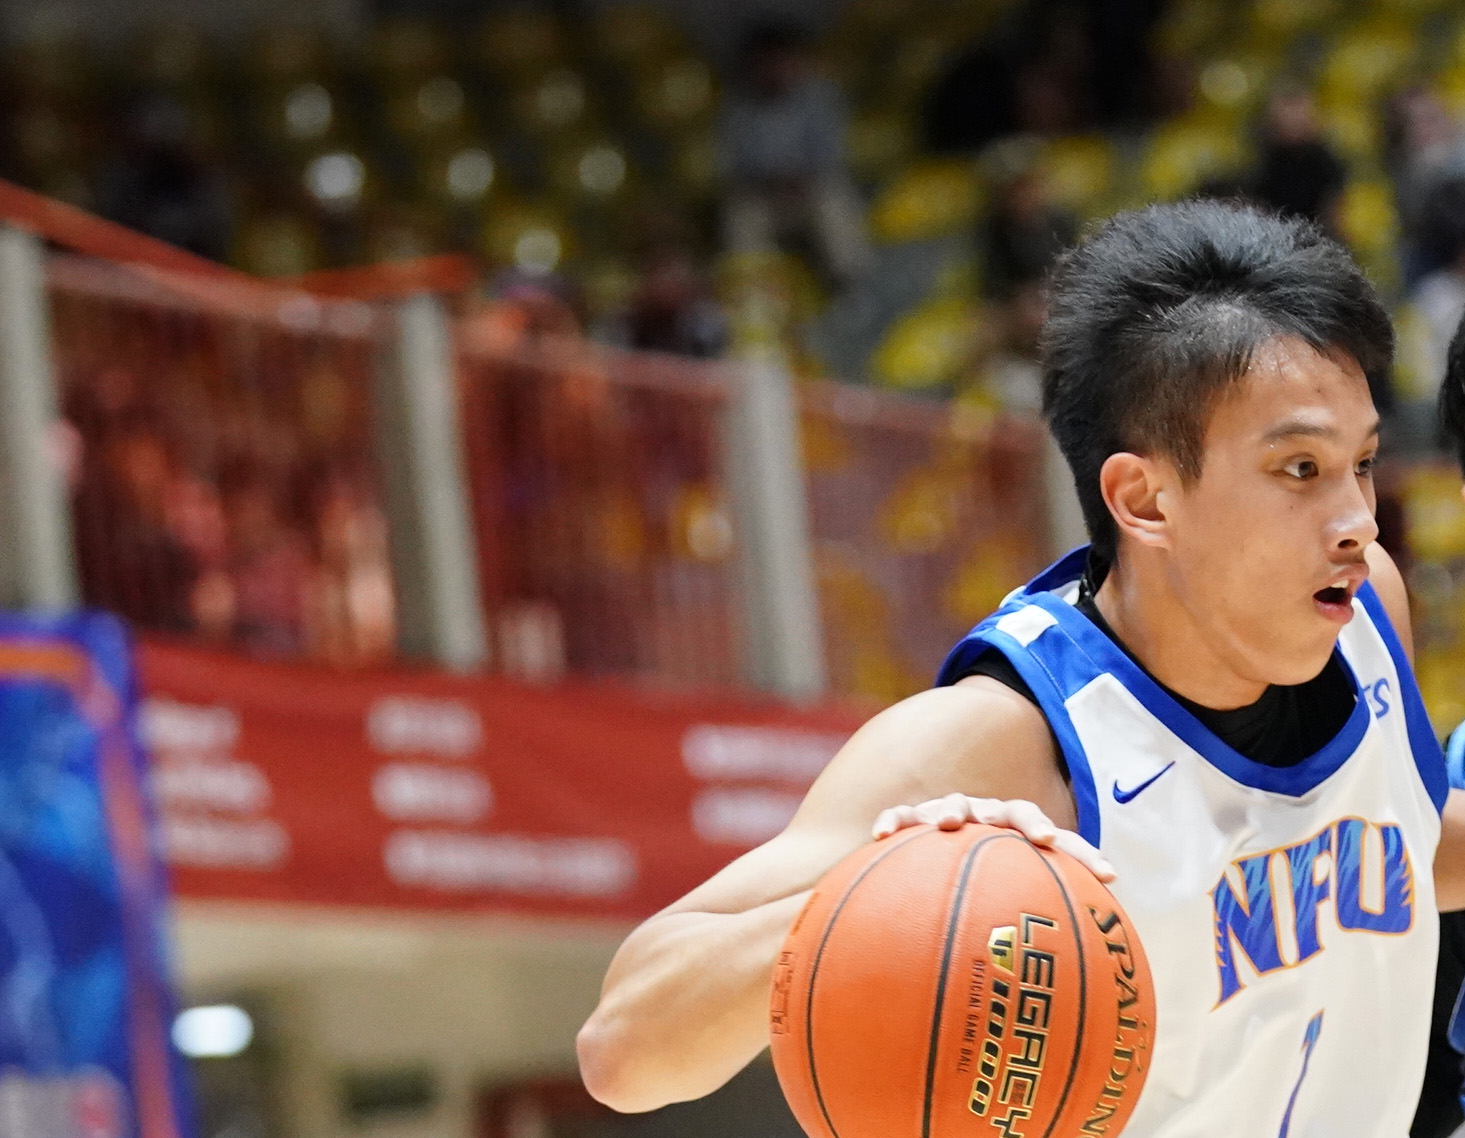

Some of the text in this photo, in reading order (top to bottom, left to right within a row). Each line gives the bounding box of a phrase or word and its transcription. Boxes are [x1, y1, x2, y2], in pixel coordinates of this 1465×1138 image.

[1206, 815, 1416, 1013] NFU
[956, 960, 986, 1074] OFFICIAL GAME BALL
